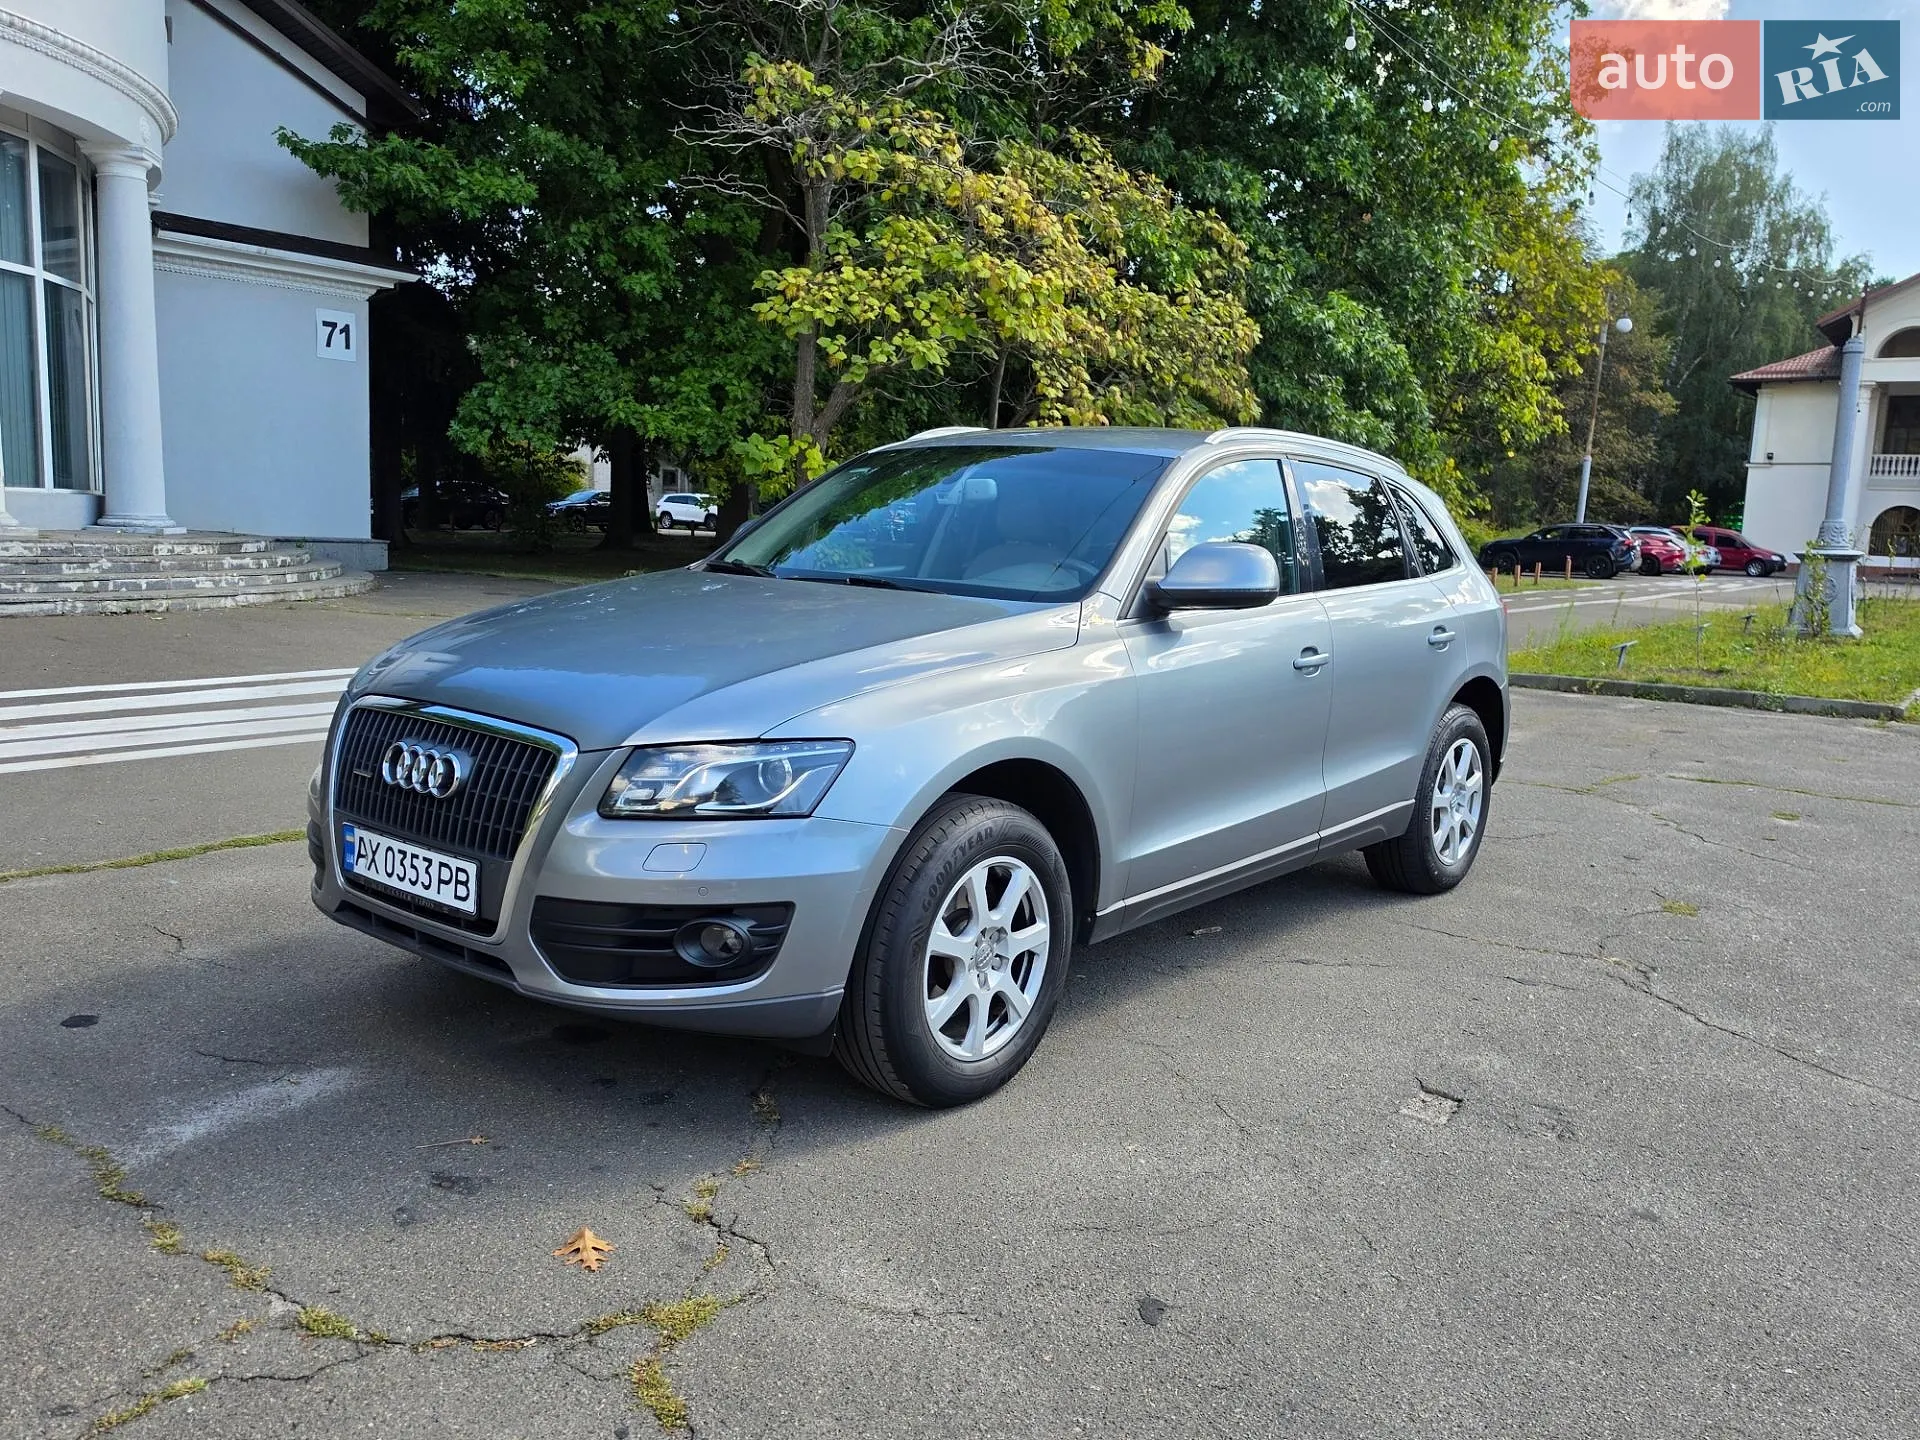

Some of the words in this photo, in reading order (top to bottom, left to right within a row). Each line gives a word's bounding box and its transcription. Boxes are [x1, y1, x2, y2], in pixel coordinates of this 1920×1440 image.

[322, 320, 350, 350] 71
[356, 836, 380, 874] AX
[385, 845, 432, 890] 0353
[437, 861, 470, 901] PB
